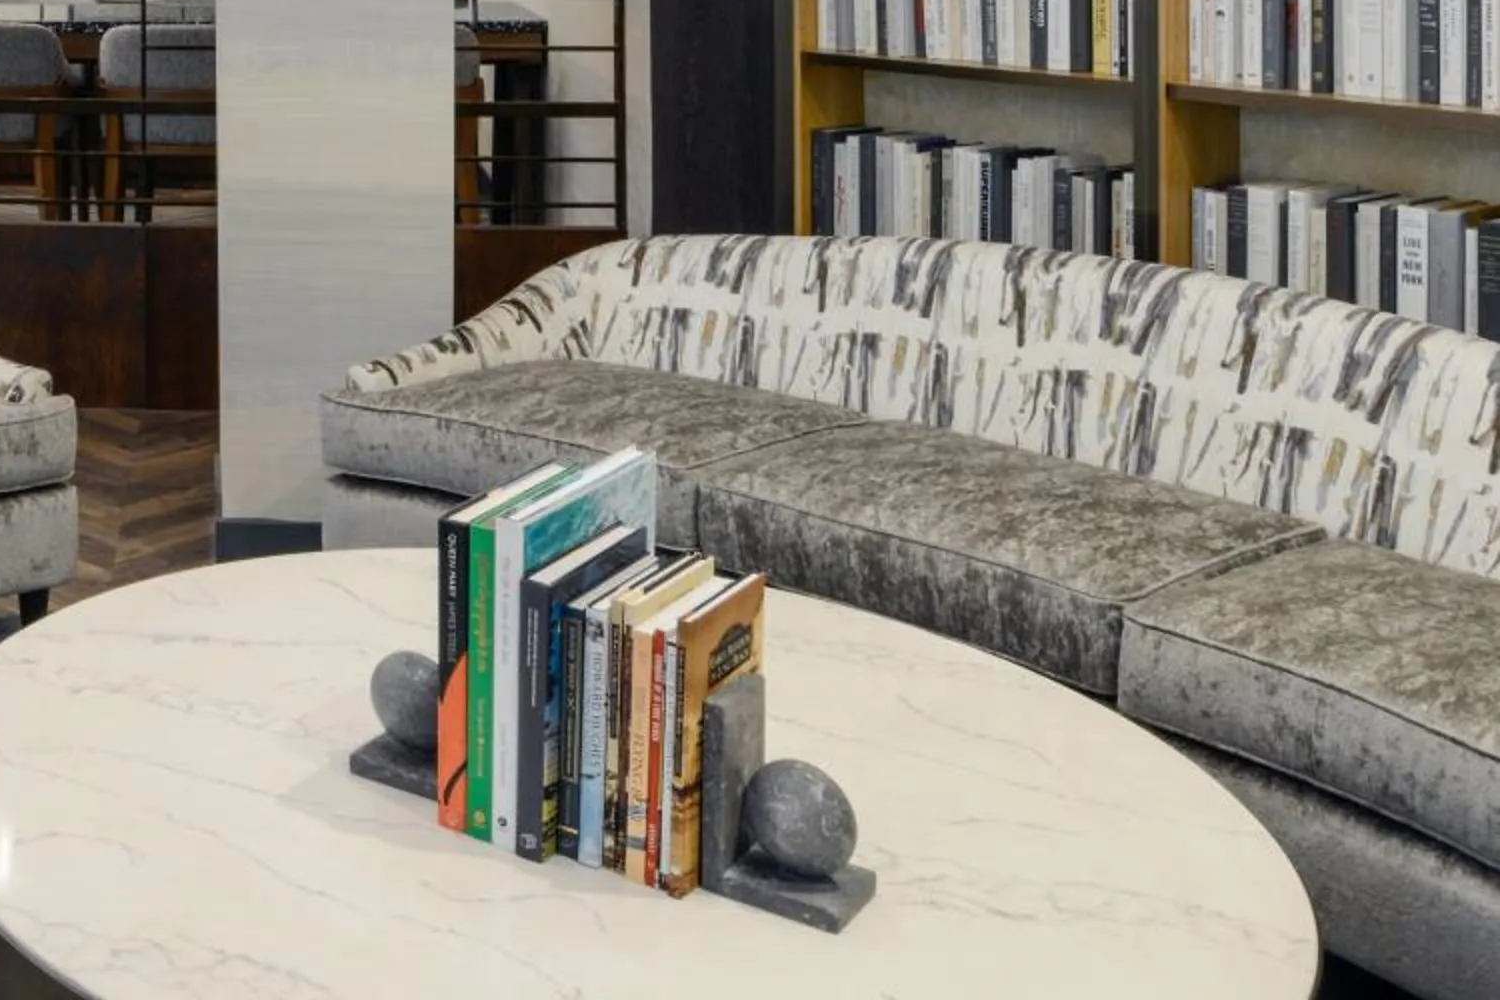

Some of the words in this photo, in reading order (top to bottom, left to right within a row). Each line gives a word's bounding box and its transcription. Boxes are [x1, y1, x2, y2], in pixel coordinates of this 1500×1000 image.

[447, 533, 457, 568] QUEEN
[448, 569, 457, 598] MARY
[591, 652, 604, 712] HOWARD
[590, 714, 603, 768] HUGHES
